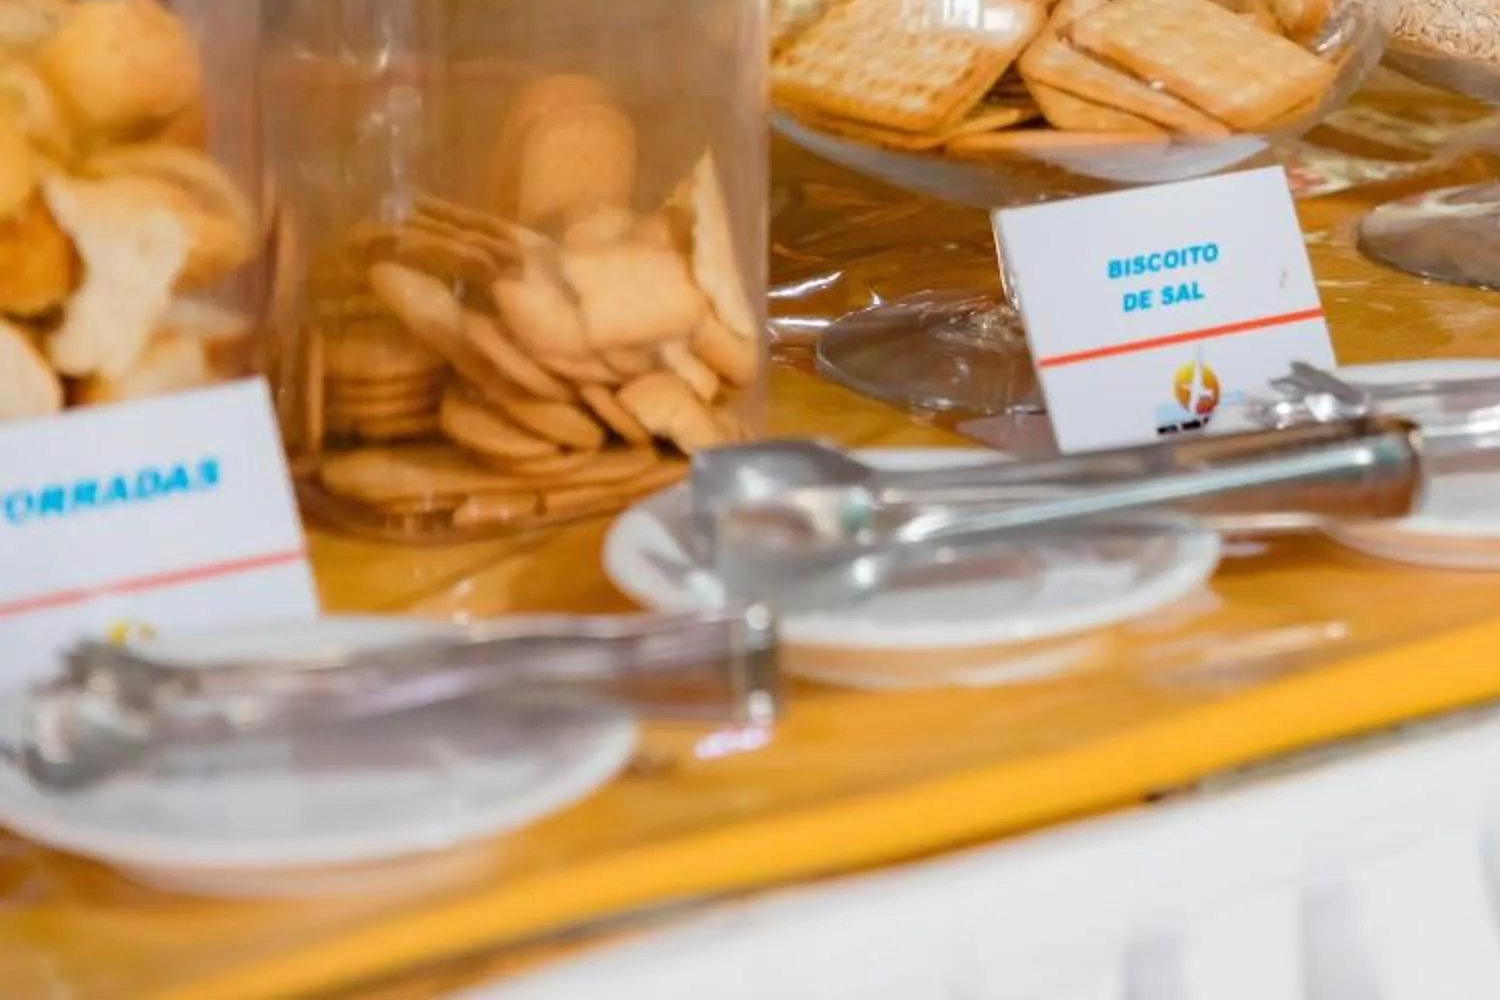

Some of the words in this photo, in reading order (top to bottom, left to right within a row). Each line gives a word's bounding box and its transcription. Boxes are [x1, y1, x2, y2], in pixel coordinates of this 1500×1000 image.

[1107, 242, 1220, 280] BISCOITO
[1122, 288, 1153, 313] DE
[1161, 280, 1205, 307] SAL
[0, 459, 221, 525] ORRADAS
